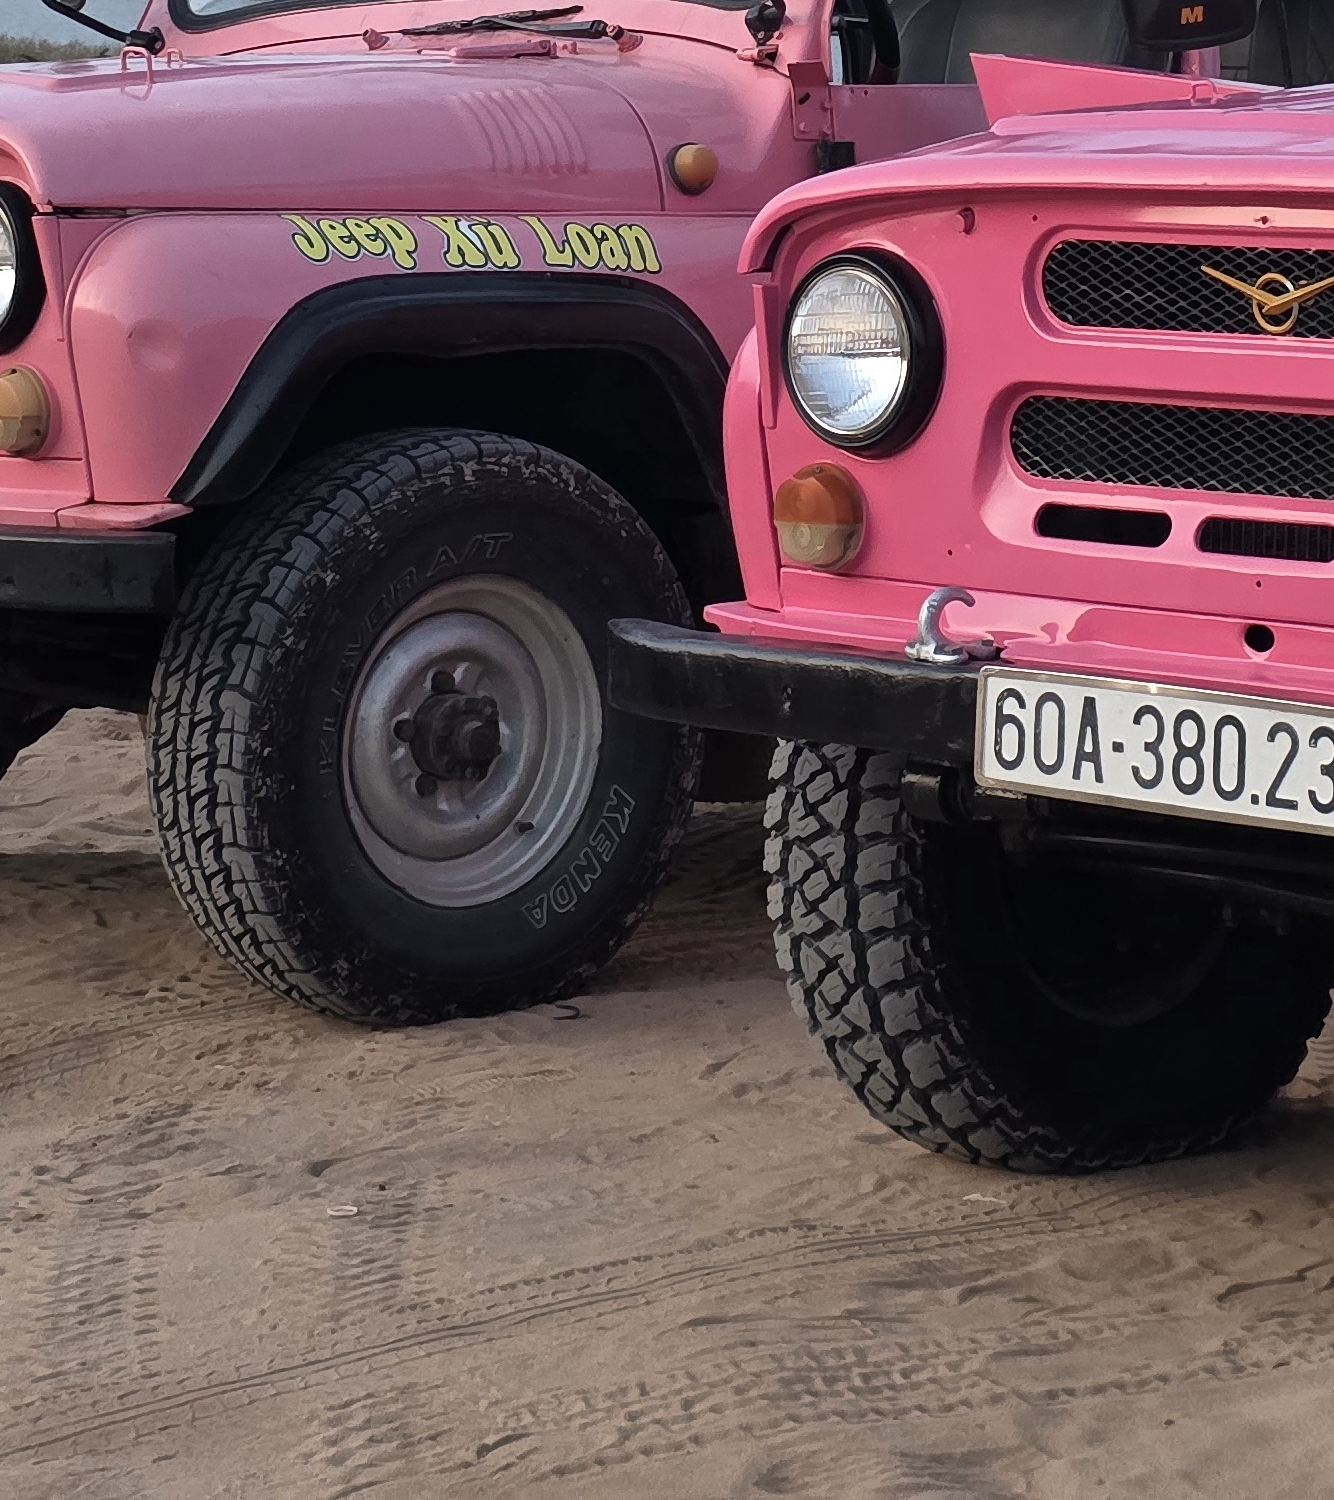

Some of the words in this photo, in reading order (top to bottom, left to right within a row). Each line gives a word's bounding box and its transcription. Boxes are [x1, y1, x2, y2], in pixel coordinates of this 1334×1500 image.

[1180, 5, 1204, 25] M
[279, 213, 418, 271] Jeep
[518, 214, 662, 273] Loan
[521, 783, 636, 929] KENDA
